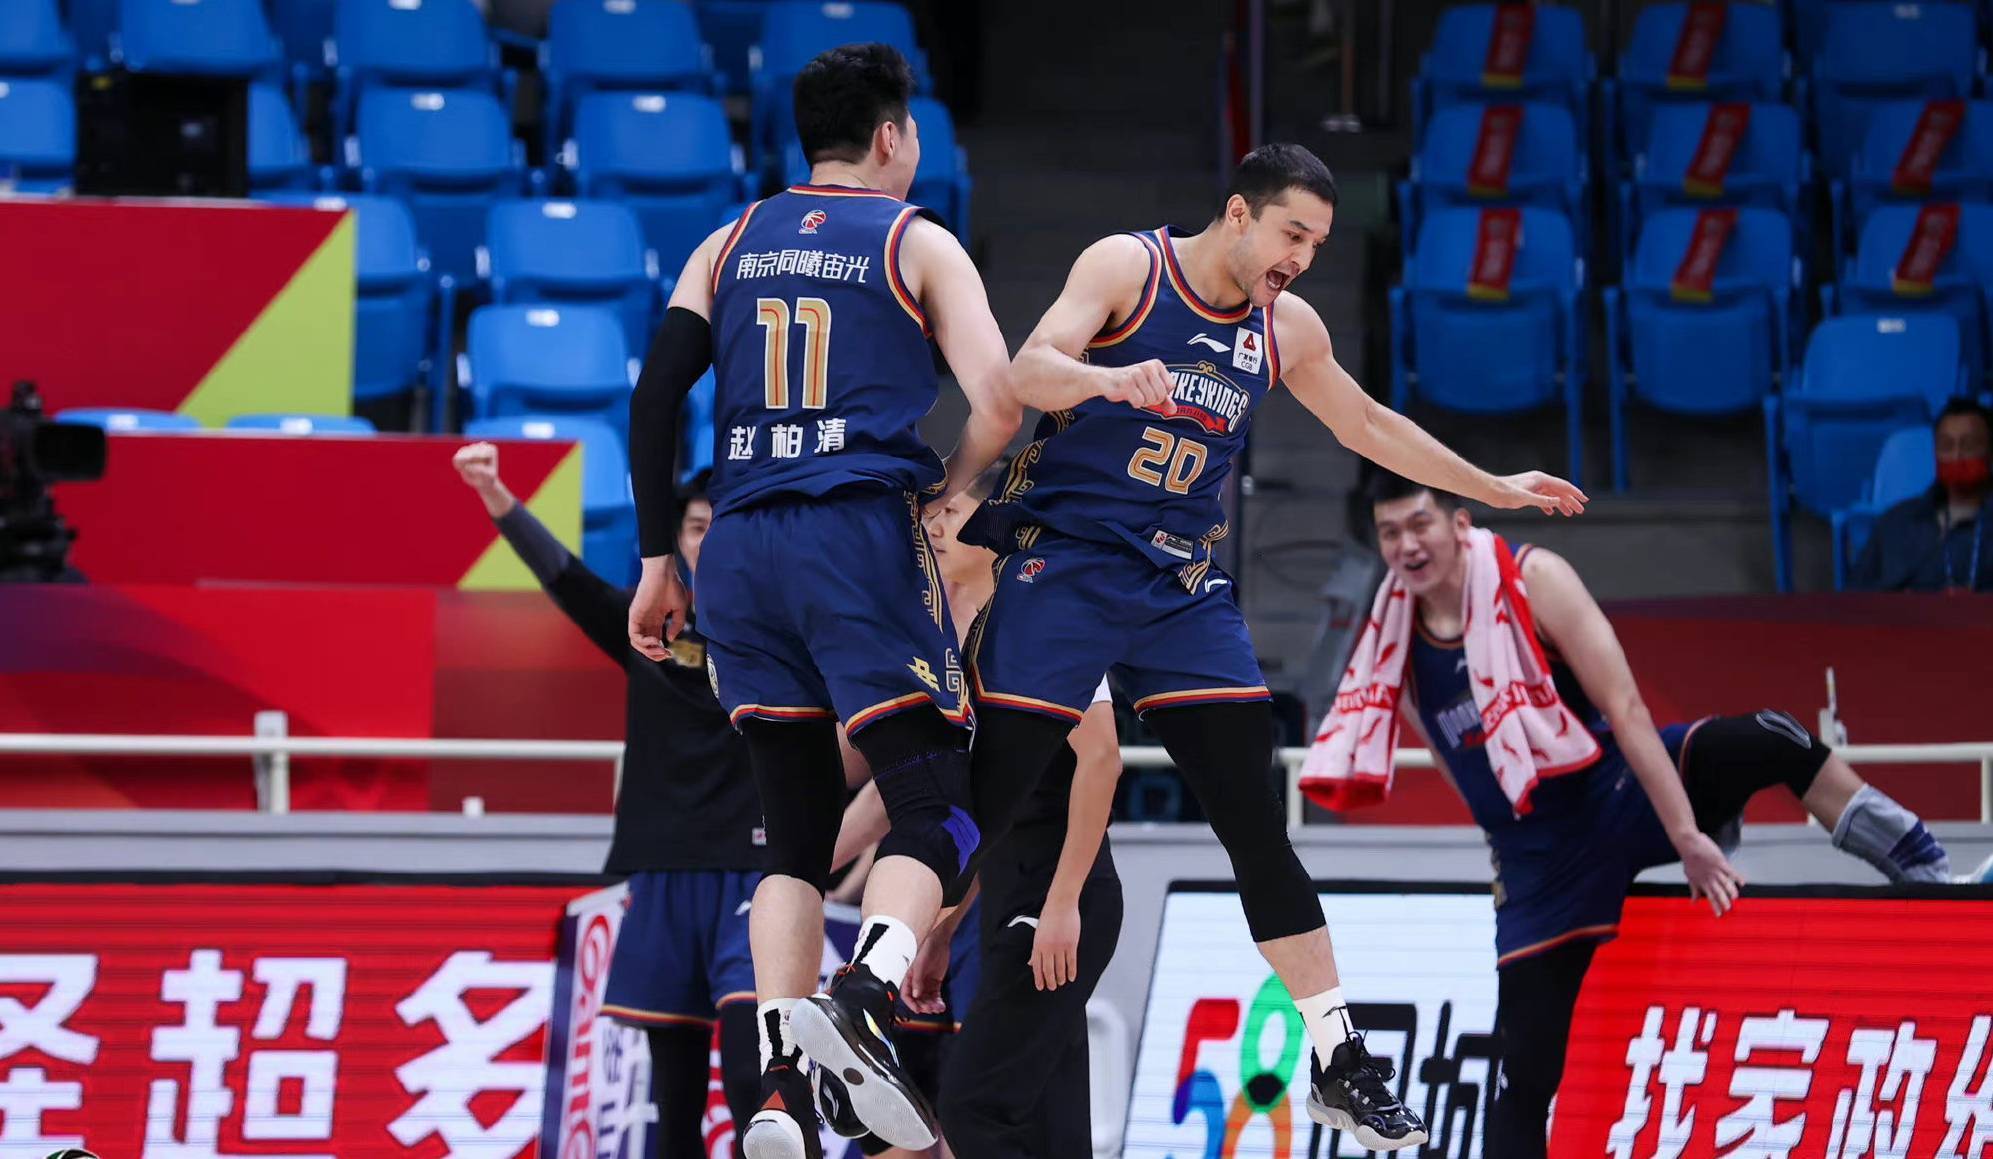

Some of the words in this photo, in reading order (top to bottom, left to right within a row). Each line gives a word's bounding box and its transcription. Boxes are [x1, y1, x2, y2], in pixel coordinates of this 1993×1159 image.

[736, 249, 869, 284] 南京同曦宙光
[756, 297, 832, 409] 11
[1241, 361, 1253, 371] CGB
[1169, 371, 1249, 433] KEYKINGS
[728, 418, 846, 461] 赵柏清
[1127, 426, 1208, 495] 20
